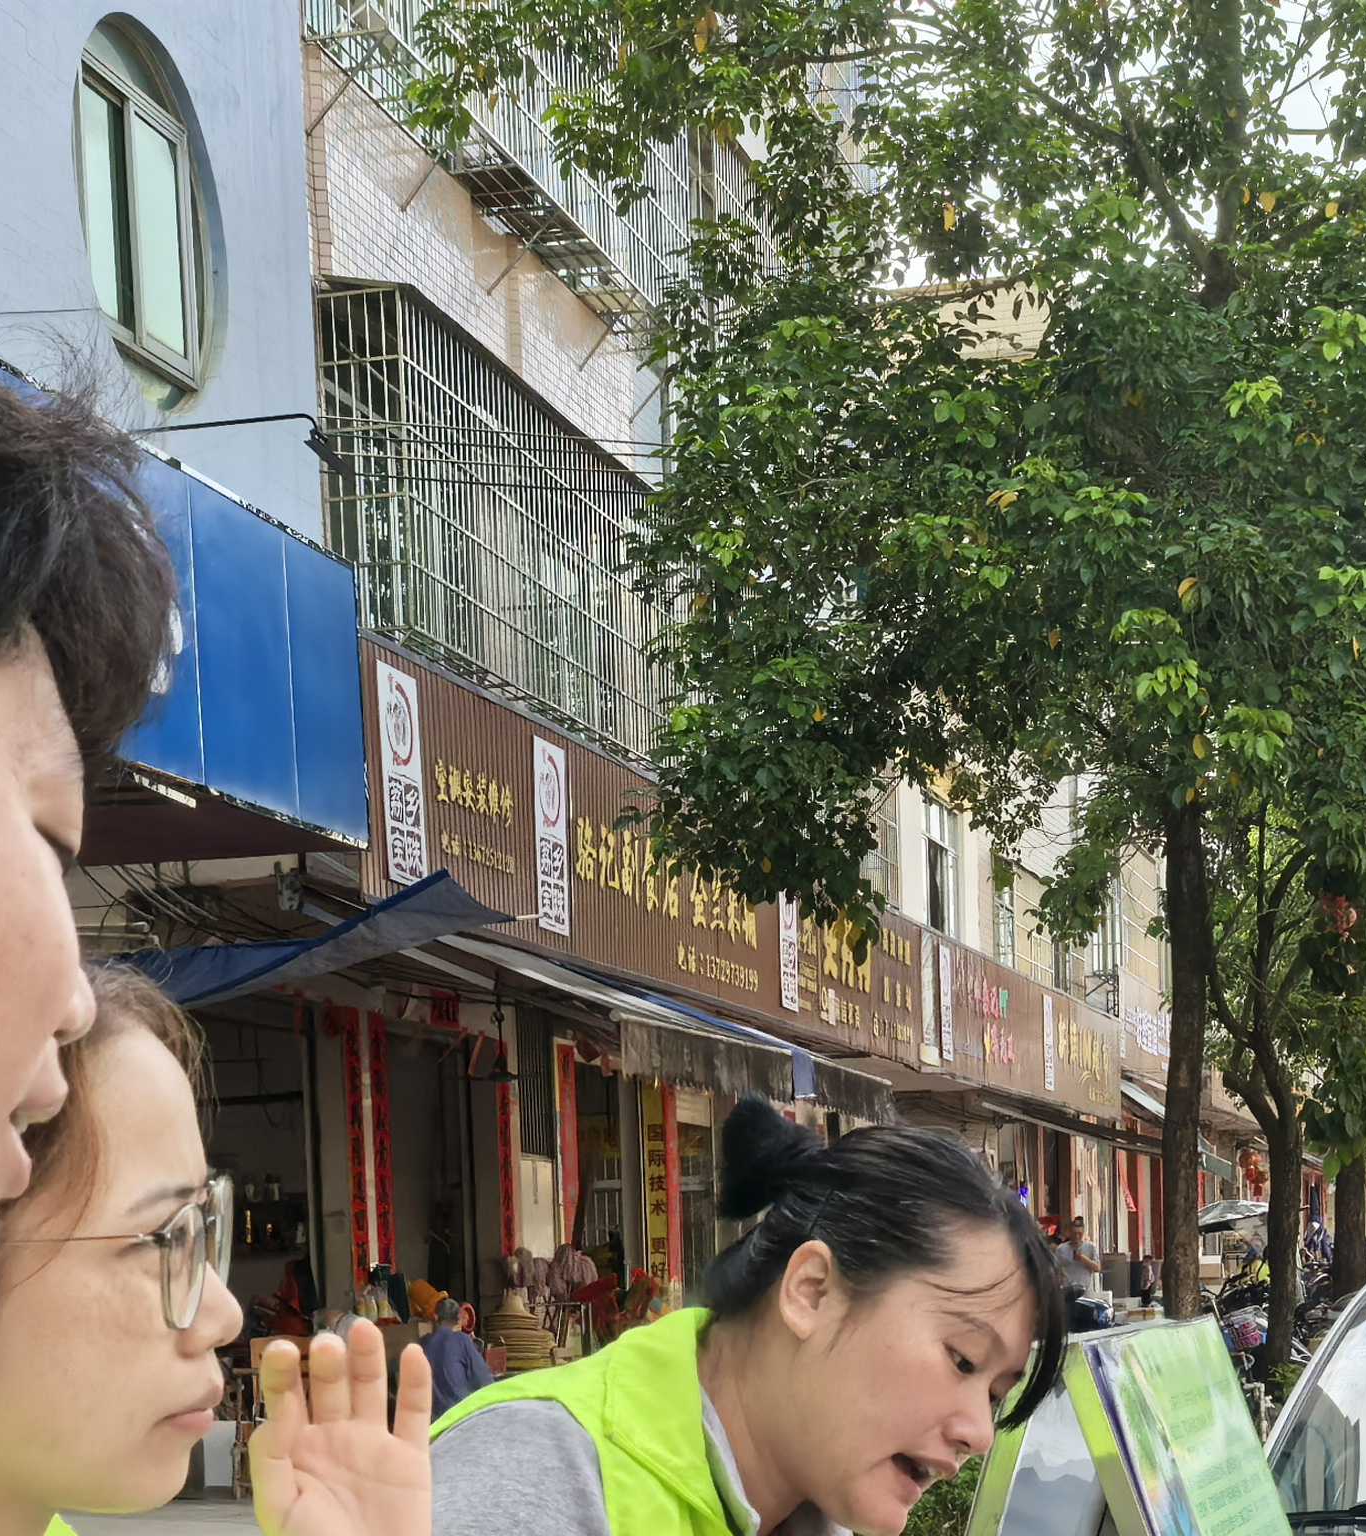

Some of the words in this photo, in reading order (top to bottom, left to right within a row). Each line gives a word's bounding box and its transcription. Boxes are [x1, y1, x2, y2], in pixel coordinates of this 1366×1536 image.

[646, 1123, 667, 1217] 国际技术
[650, 1237, 668, 1281] 更好
